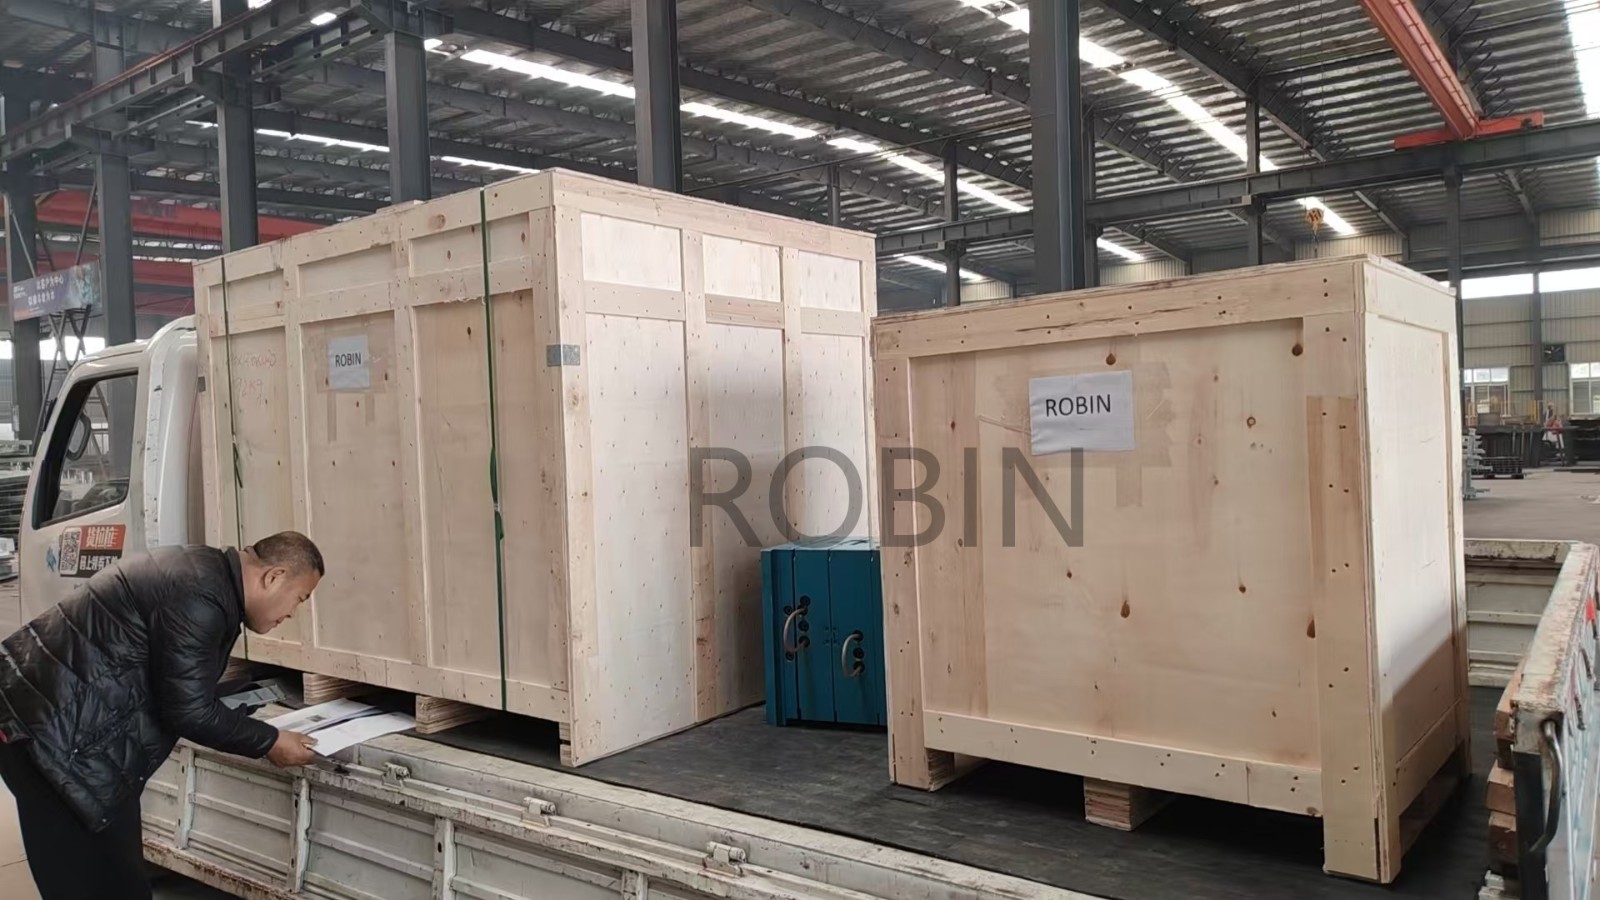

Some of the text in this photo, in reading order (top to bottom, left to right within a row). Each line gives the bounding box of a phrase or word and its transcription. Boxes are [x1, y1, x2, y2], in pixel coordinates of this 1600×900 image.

[335, 352, 362, 367] ROBIN
[1045, 394, 1111, 417] ROBIN
[86, 526, 118, 549] 货拉拉
